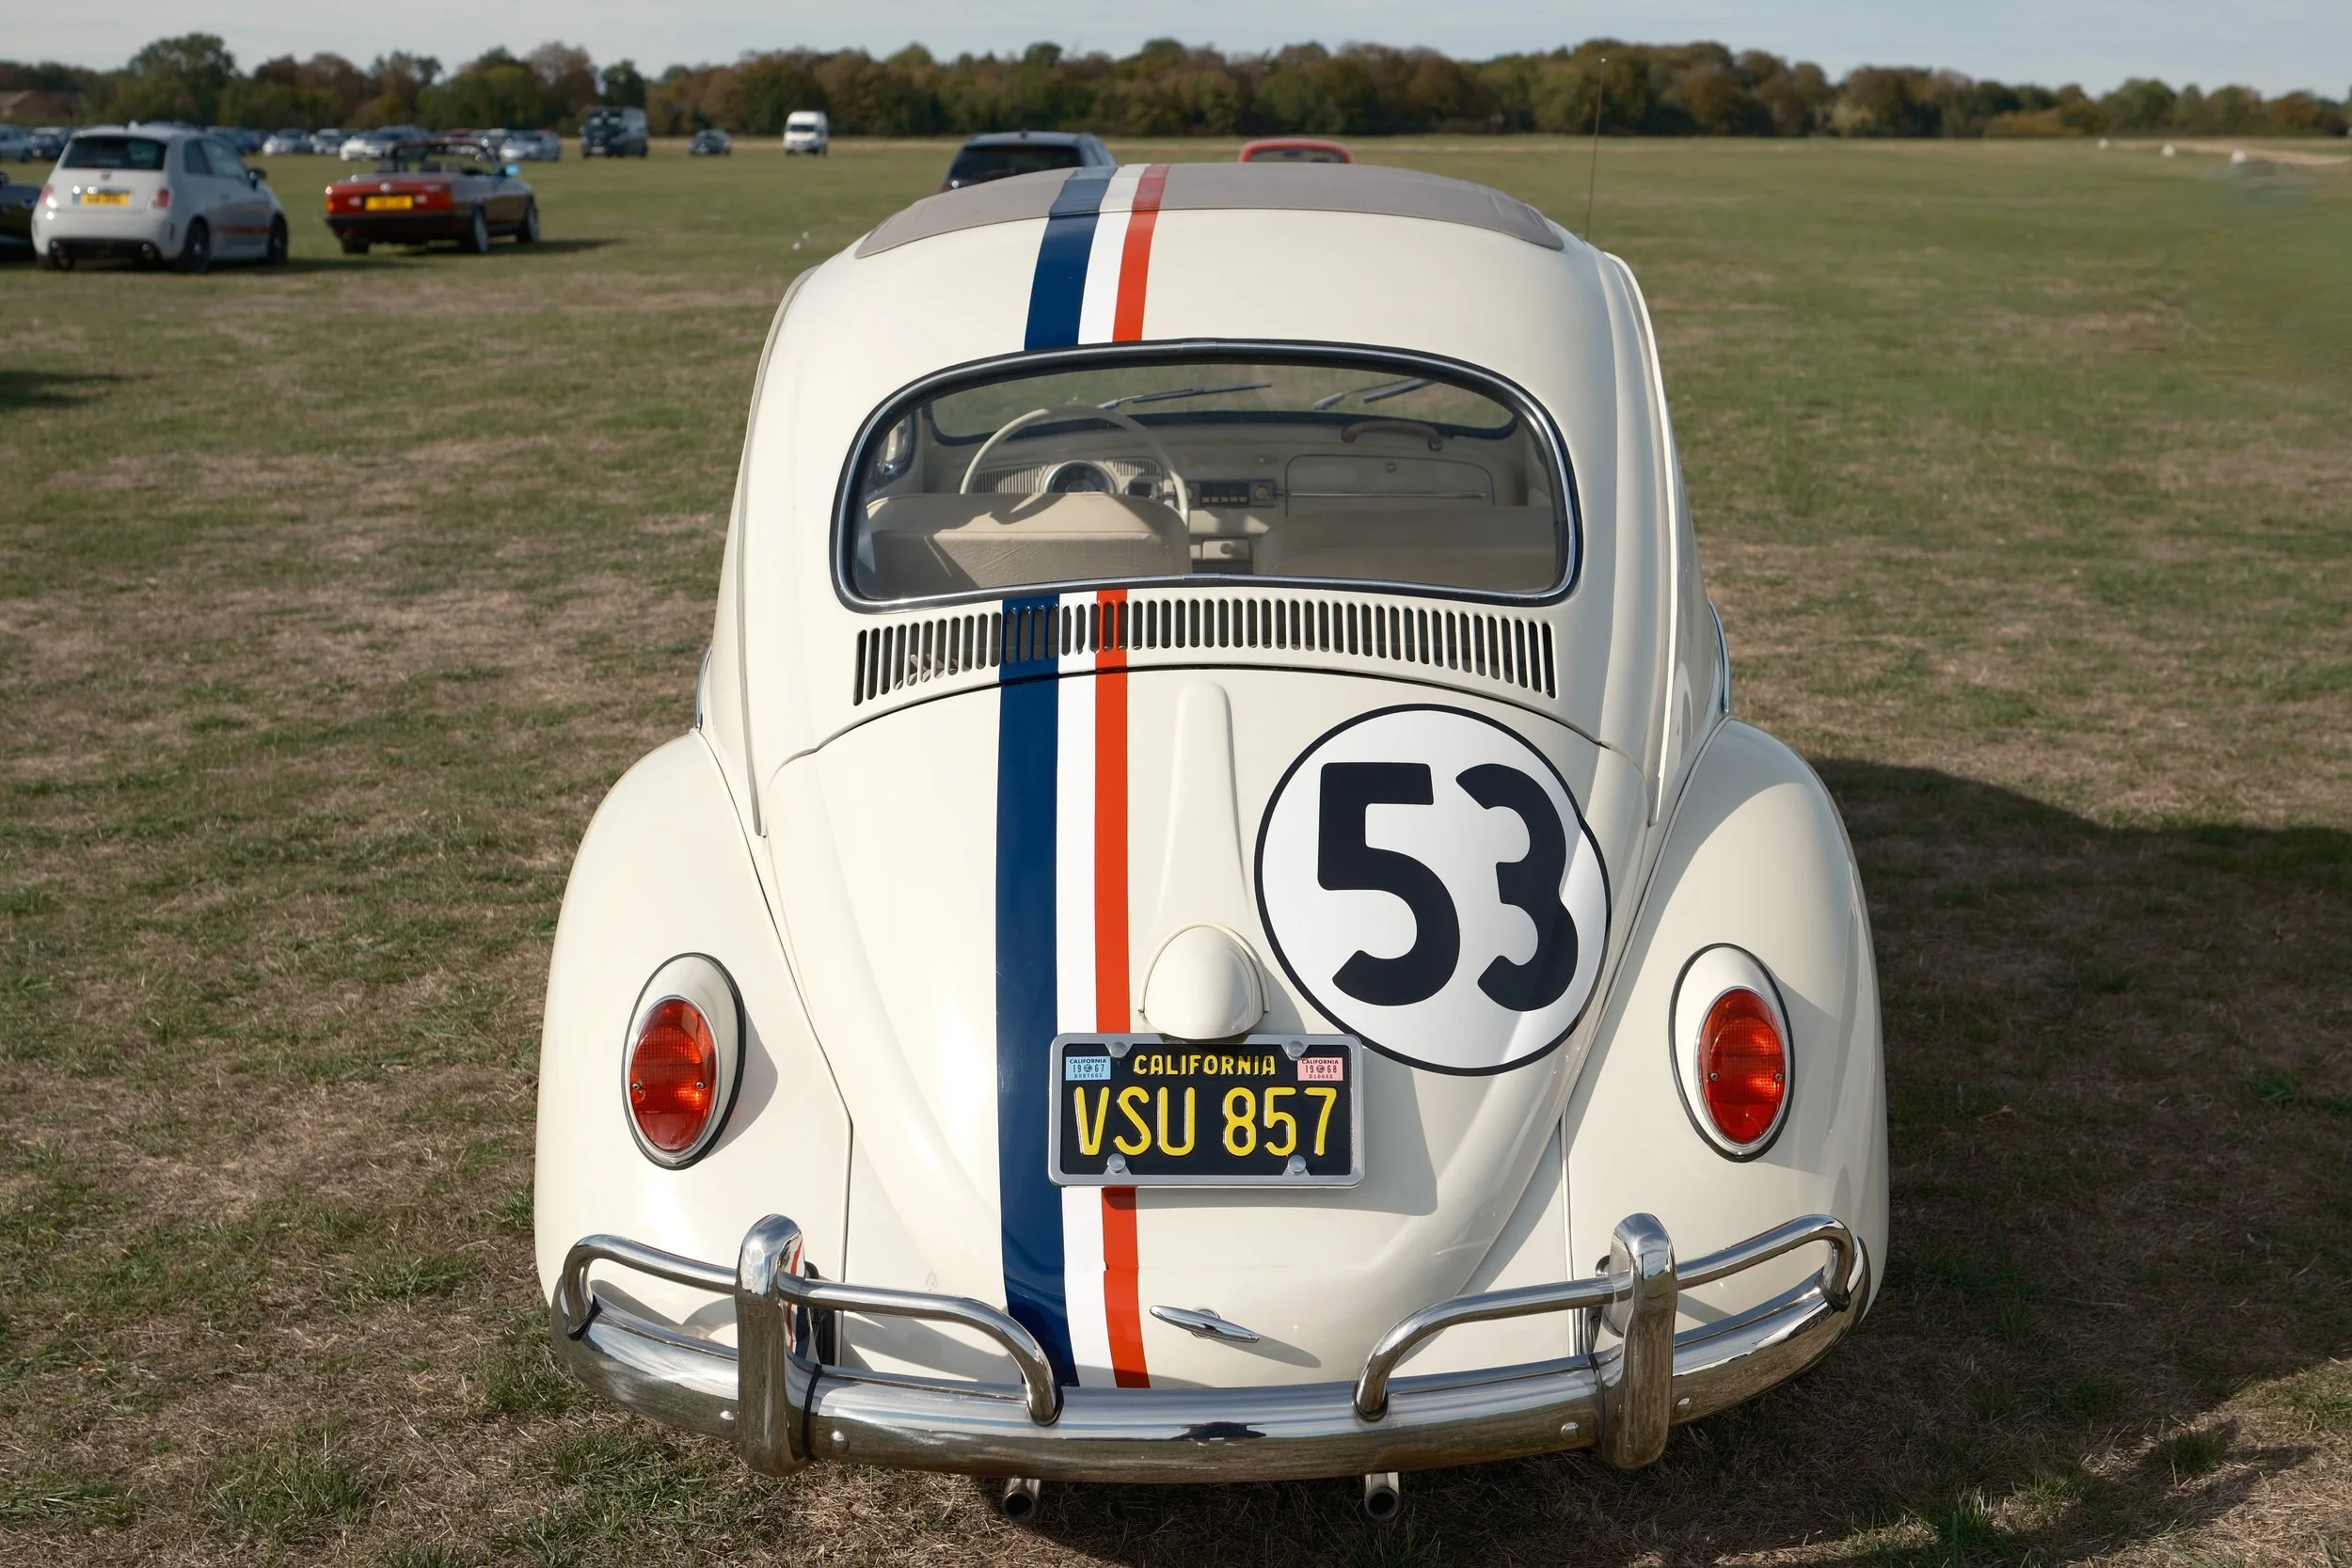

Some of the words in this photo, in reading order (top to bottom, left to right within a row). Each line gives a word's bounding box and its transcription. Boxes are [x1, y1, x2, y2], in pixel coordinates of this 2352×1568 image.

[1317, 762, 1578, 1012] 53
[1133, 1053, 1277, 1075] CALIFORNIA
[1073, 1085, 1196, 1157] VSU
[1223, 1085, 1338, 1157] 857
